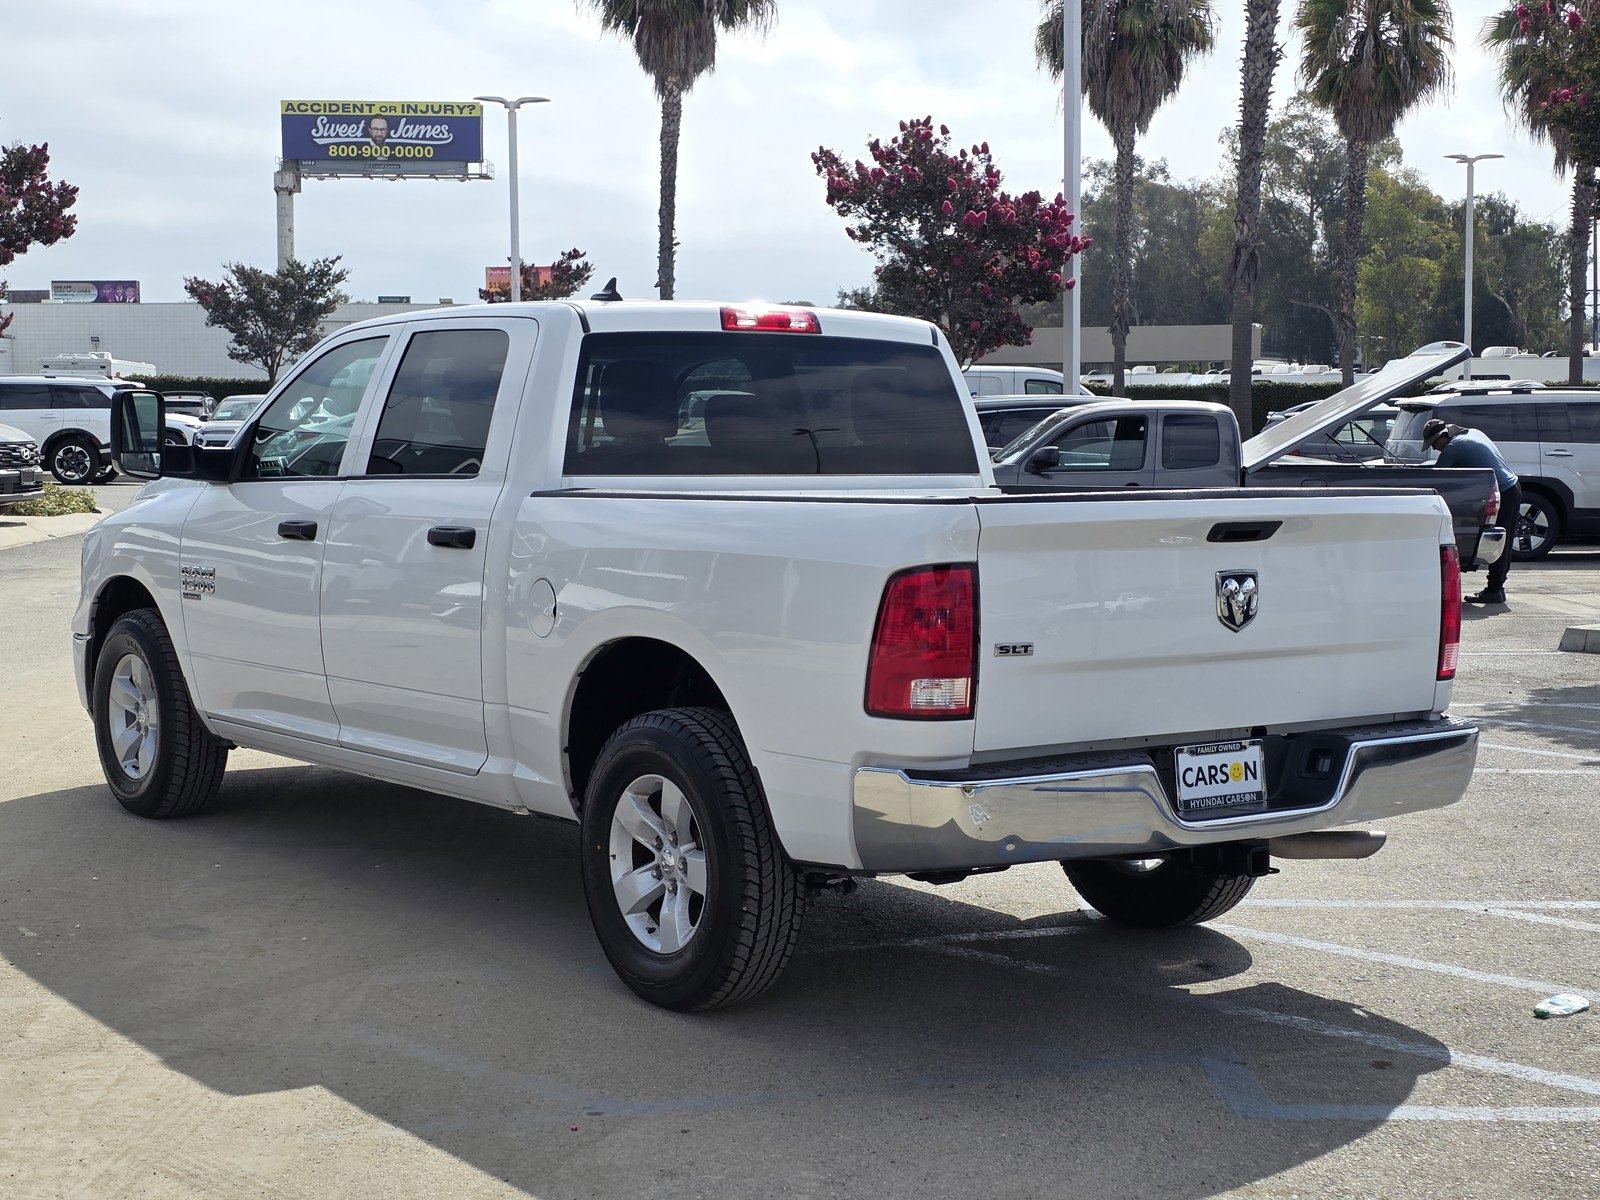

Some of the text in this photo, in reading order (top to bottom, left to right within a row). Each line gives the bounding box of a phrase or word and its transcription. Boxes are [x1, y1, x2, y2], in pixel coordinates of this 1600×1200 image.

[284, 102, 476, 115] ACCIDENT OR INJURY?
[311, 116, 451, 139] Sweet James
[181, 564, 216, 580] RAM
[181, 579, 216, 595] 1500
[998, 645, 1032, 654] SLT
[1197, 743, 1241, 754] FAMILY OWNED
[1190, 797, 1225, 809] HYUNDAI
